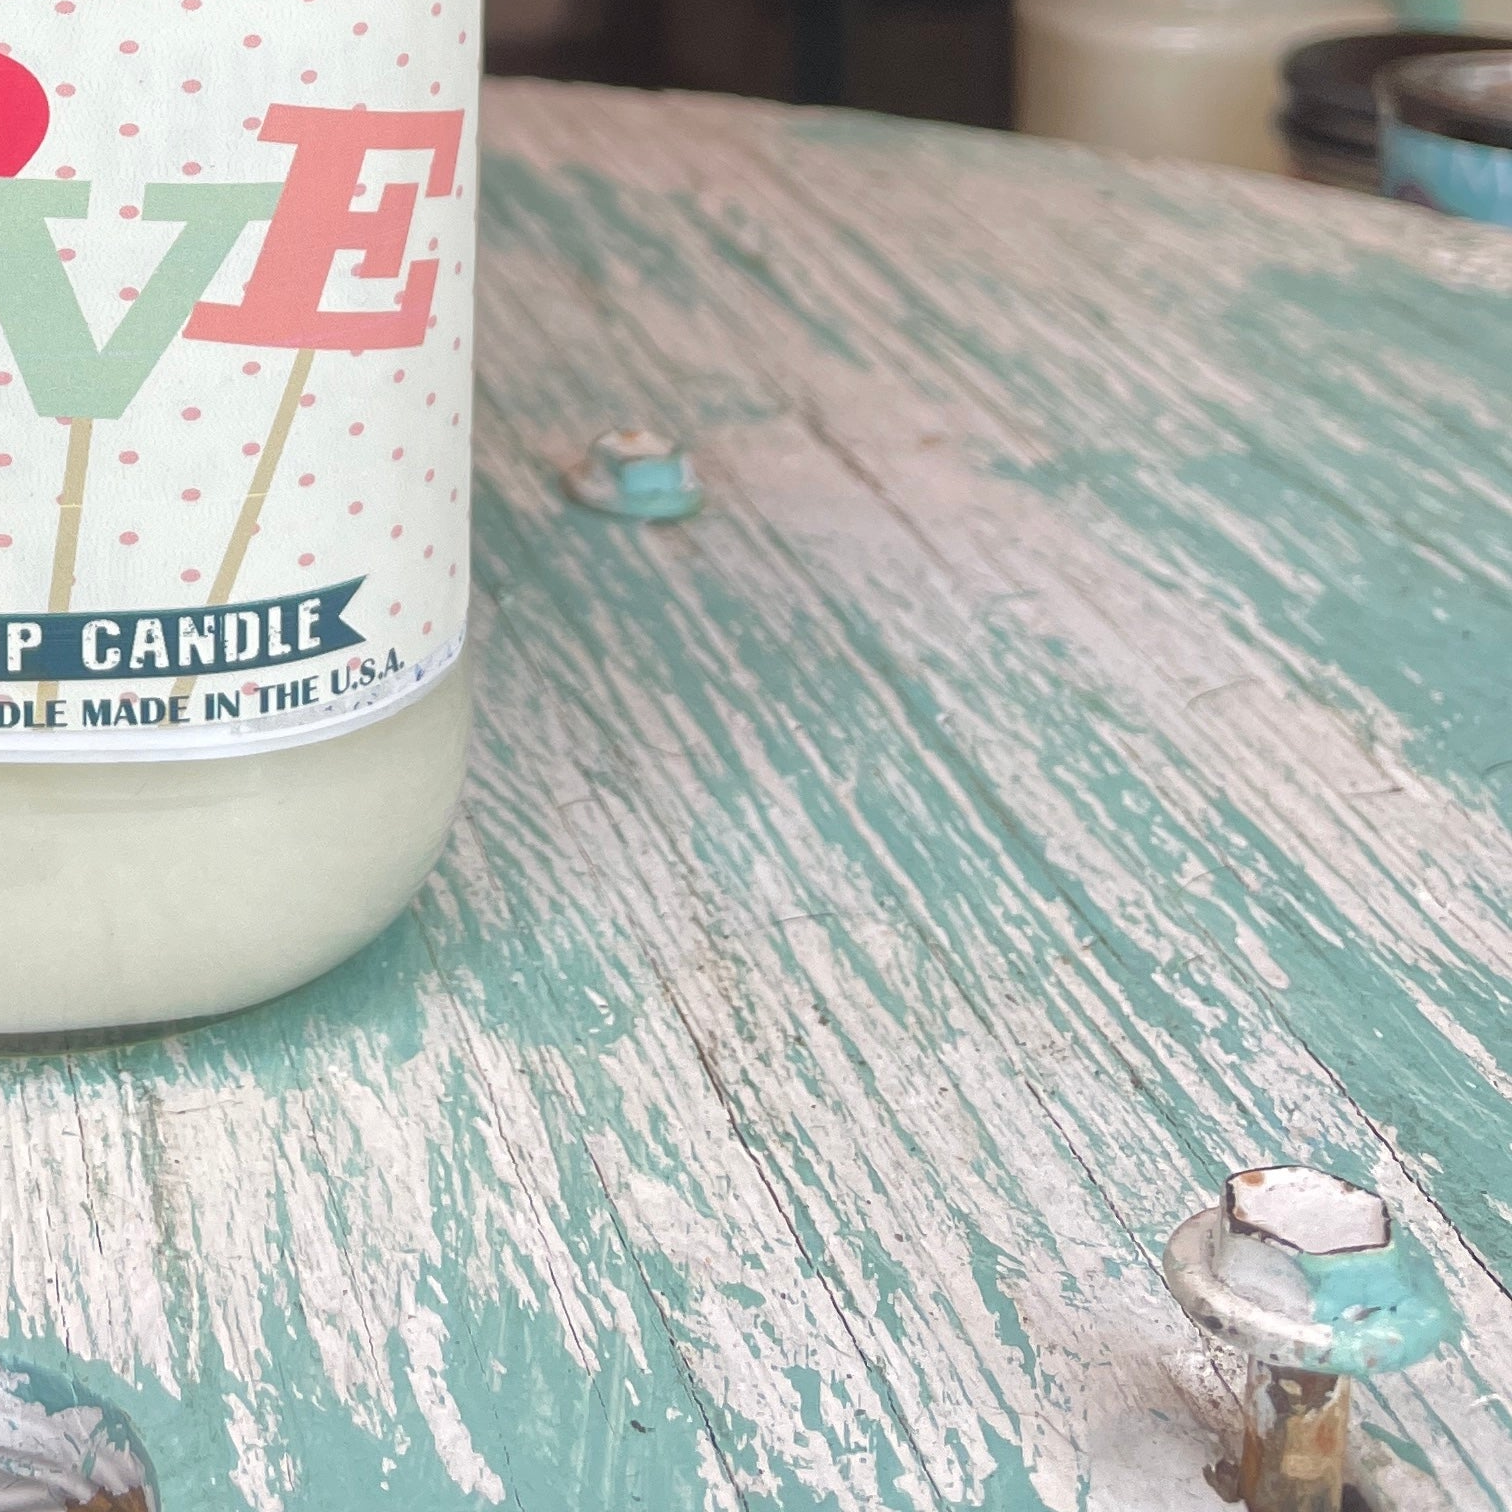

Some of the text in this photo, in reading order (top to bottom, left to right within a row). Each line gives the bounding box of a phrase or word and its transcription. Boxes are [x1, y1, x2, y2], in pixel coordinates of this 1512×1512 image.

[80, 596, 323, 672] CANDLE
[82, 695, 189, 728] MADE
[204, 689, 241, 721] IN
[257, 673, 320, 714] THE
[330, 646, 406, 696] U.S.A.
